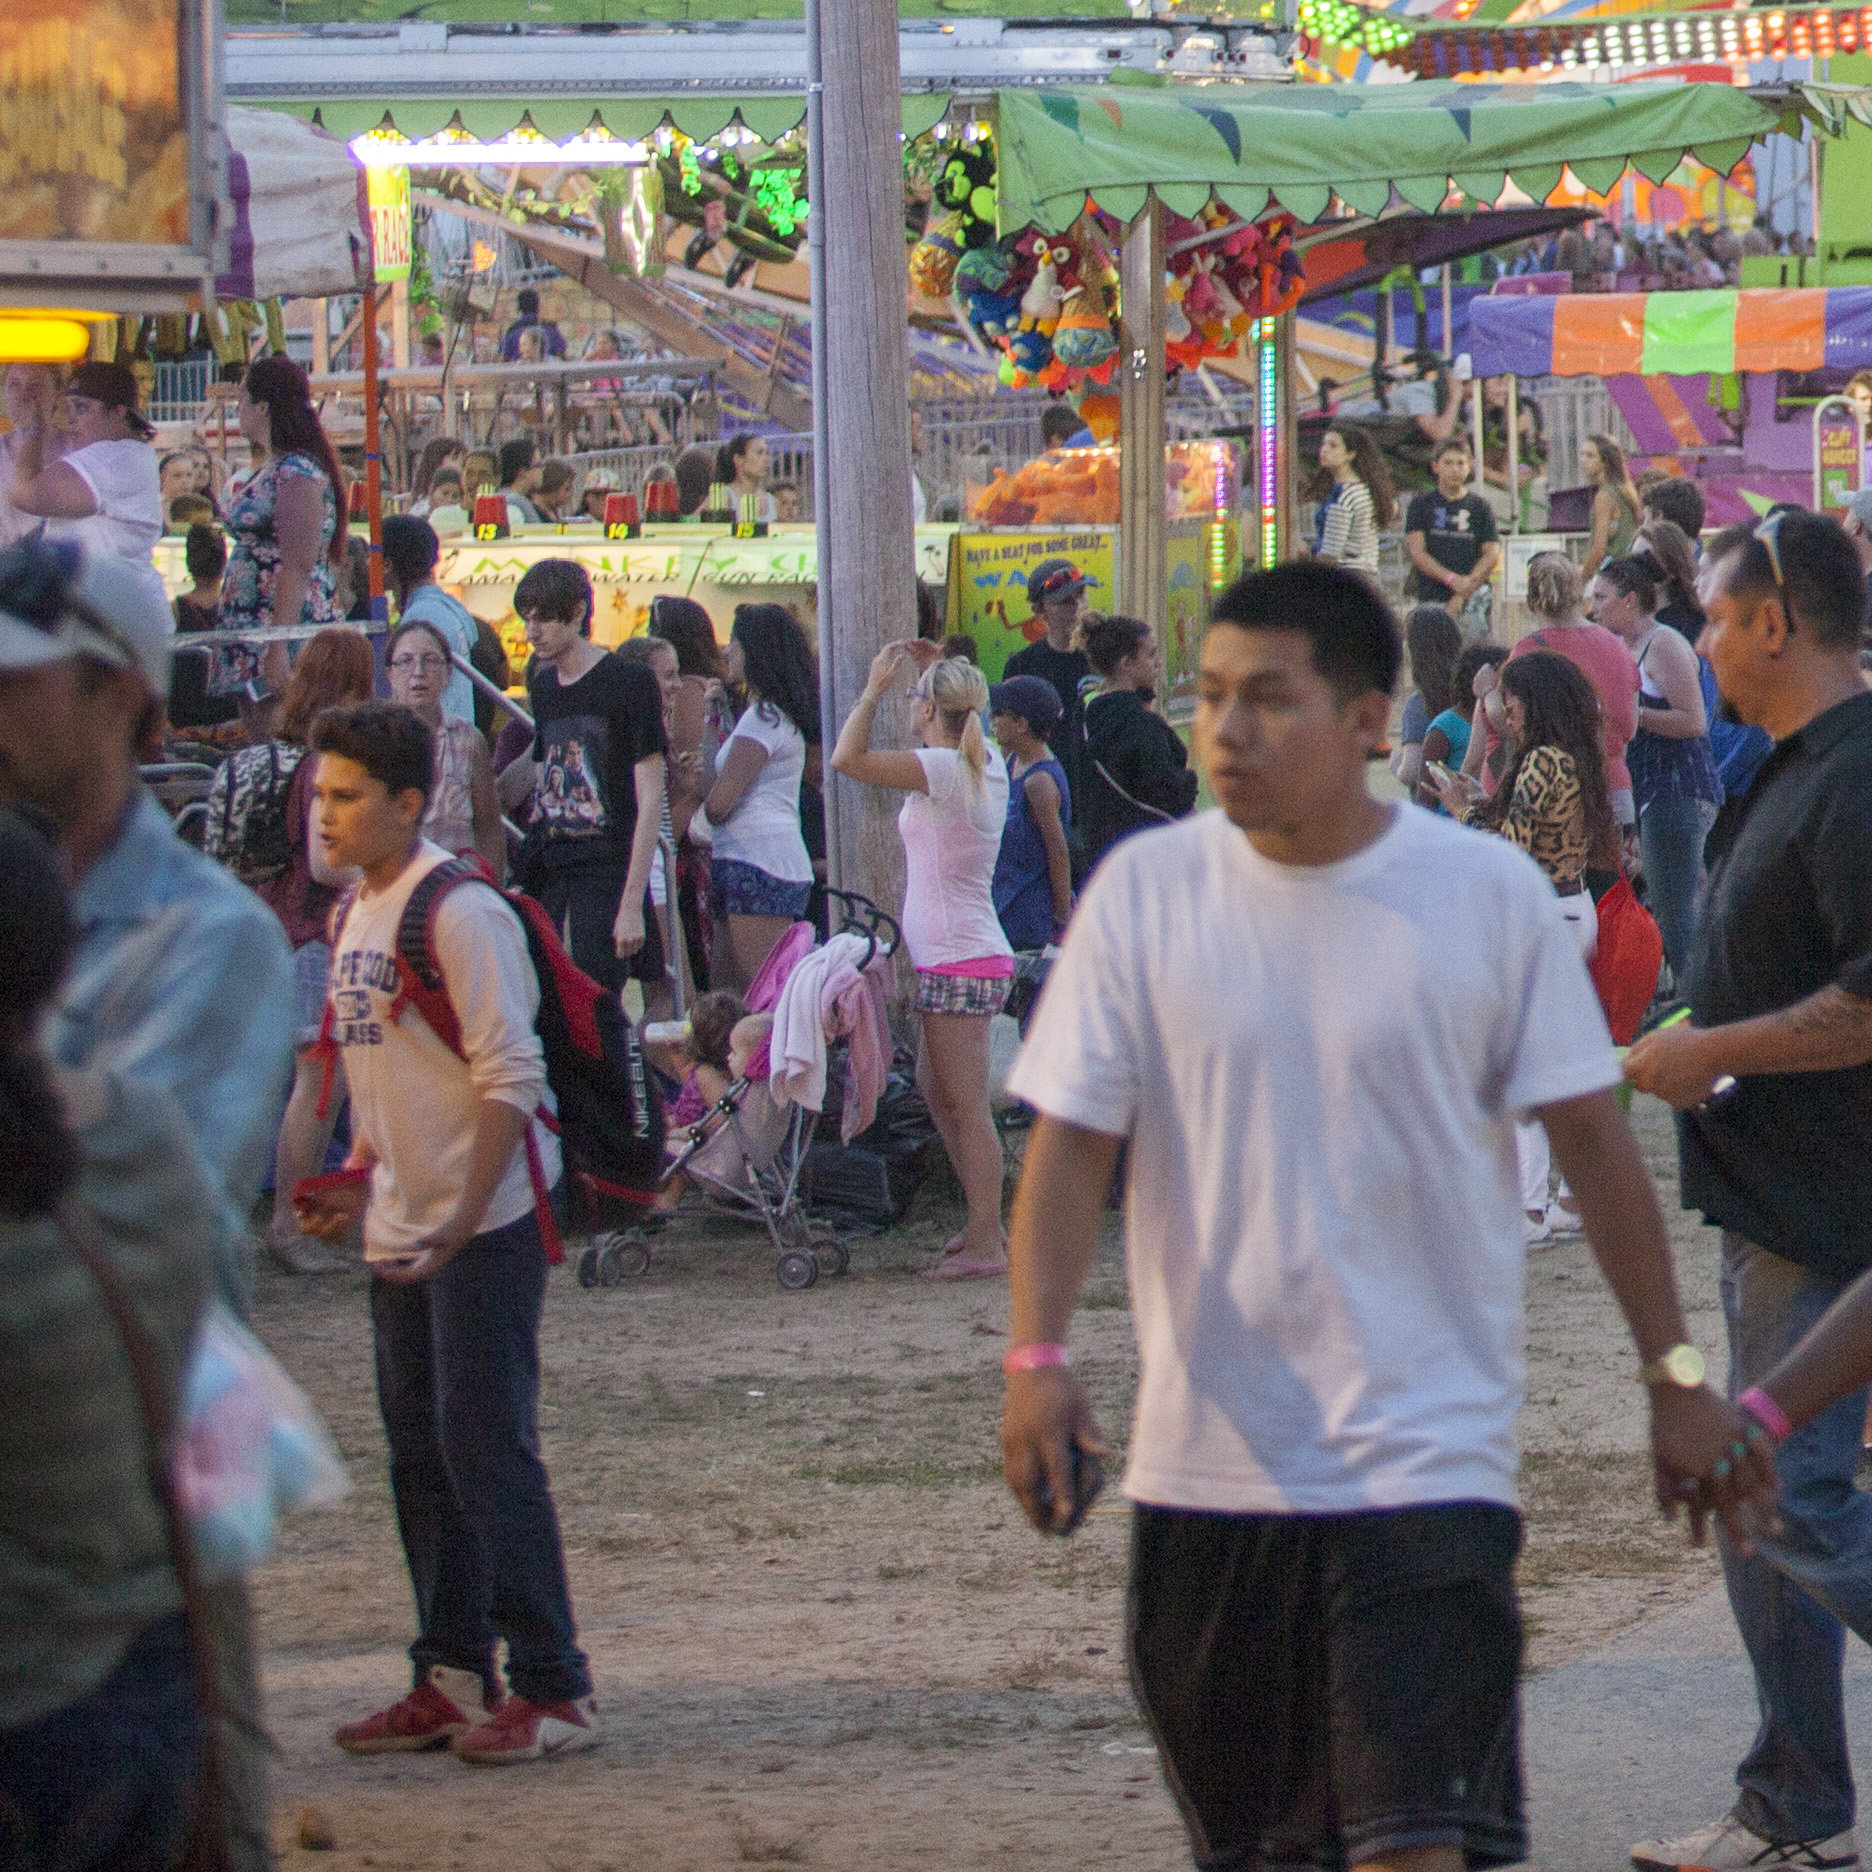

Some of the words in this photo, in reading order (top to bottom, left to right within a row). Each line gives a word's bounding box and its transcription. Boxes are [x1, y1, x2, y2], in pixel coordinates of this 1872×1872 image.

[477, 523, 498, 540] 13
[608, 522, 629, 540] 14
[473, 555, 738, 574] MNKEY
